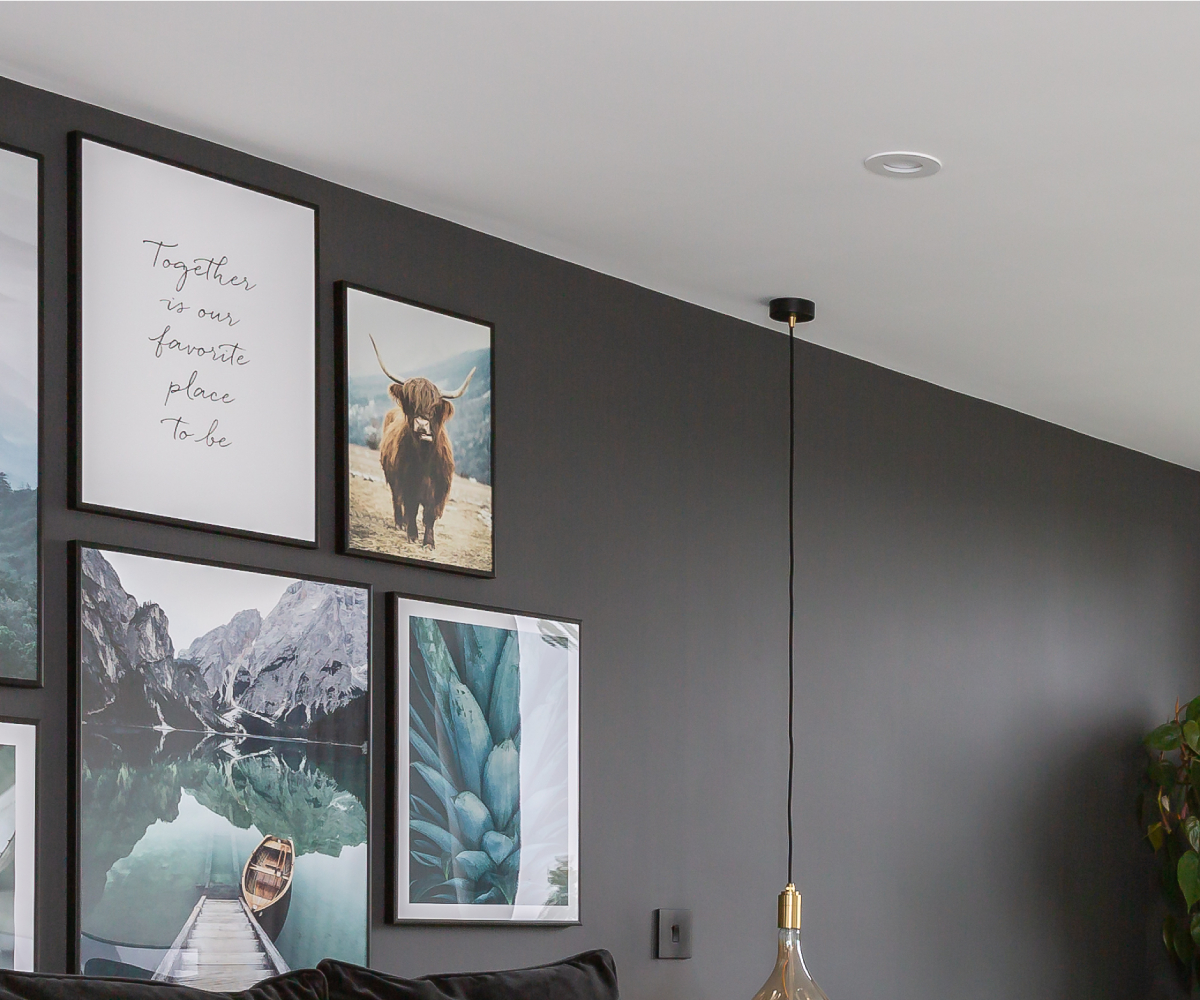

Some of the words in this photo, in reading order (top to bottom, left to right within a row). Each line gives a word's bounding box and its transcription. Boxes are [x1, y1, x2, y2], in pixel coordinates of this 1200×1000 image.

[143, 240, 257, 292] Together
[159, 298, 190, 314] is
[198, 309, 240, 327] our
[148, 325, 250, 366] favorite
[164, 370, 236, 406] place
[194, 419, 233, 448] be
